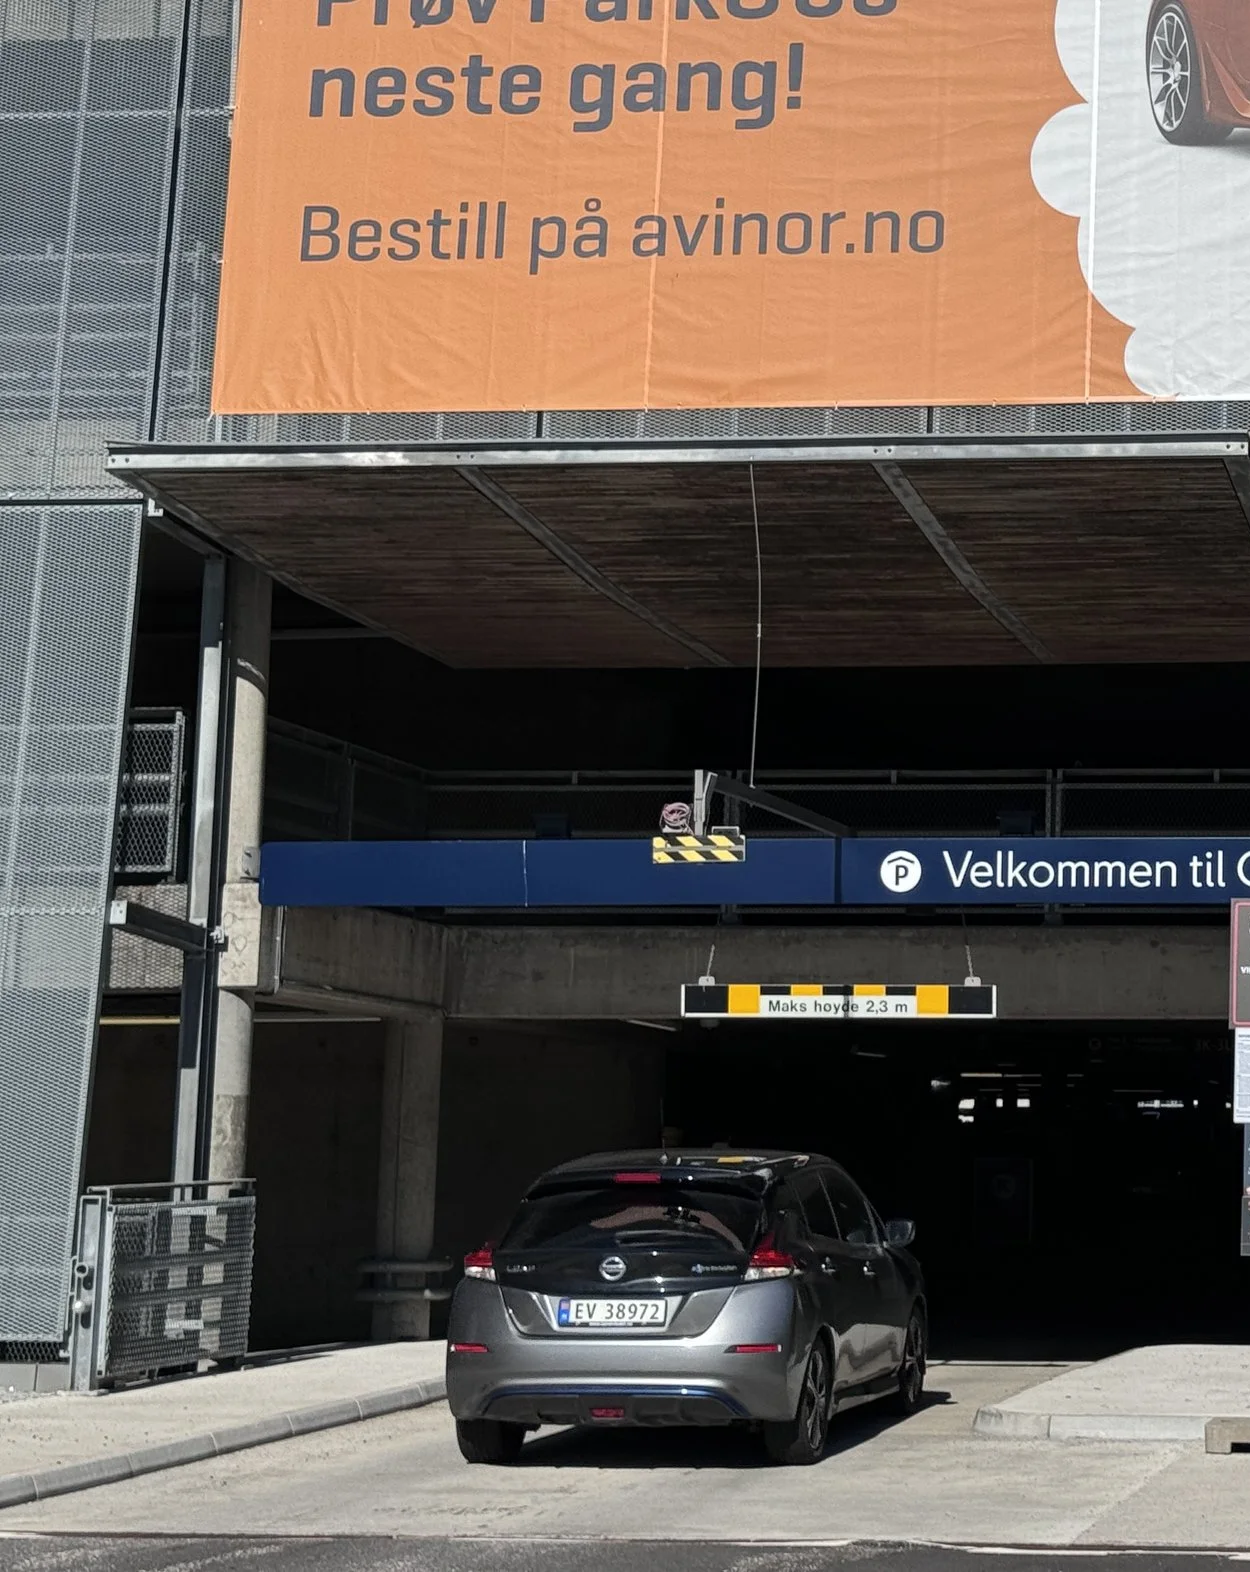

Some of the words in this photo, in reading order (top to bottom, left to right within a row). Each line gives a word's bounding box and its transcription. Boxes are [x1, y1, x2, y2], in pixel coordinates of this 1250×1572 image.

[309, 54, 543, 118] neste
[568, 42, 805, 133] gang!
[300, 201, 507, 262] Bestill
[529, 198, 608, 275] på
[631, 197, 945, 257] avinor.no
[942, 850, 1178, 889] Velkommen
[1189, 850, 1226, 889] til
[768, 1000, 807, 1013] Maks
[866, 1000, 889, 1014] 2,3
[895, 1003, 908, 1013] m
[575, 1303, 597, 1320] EV
[605, 1303, 660, 1320] 38972
